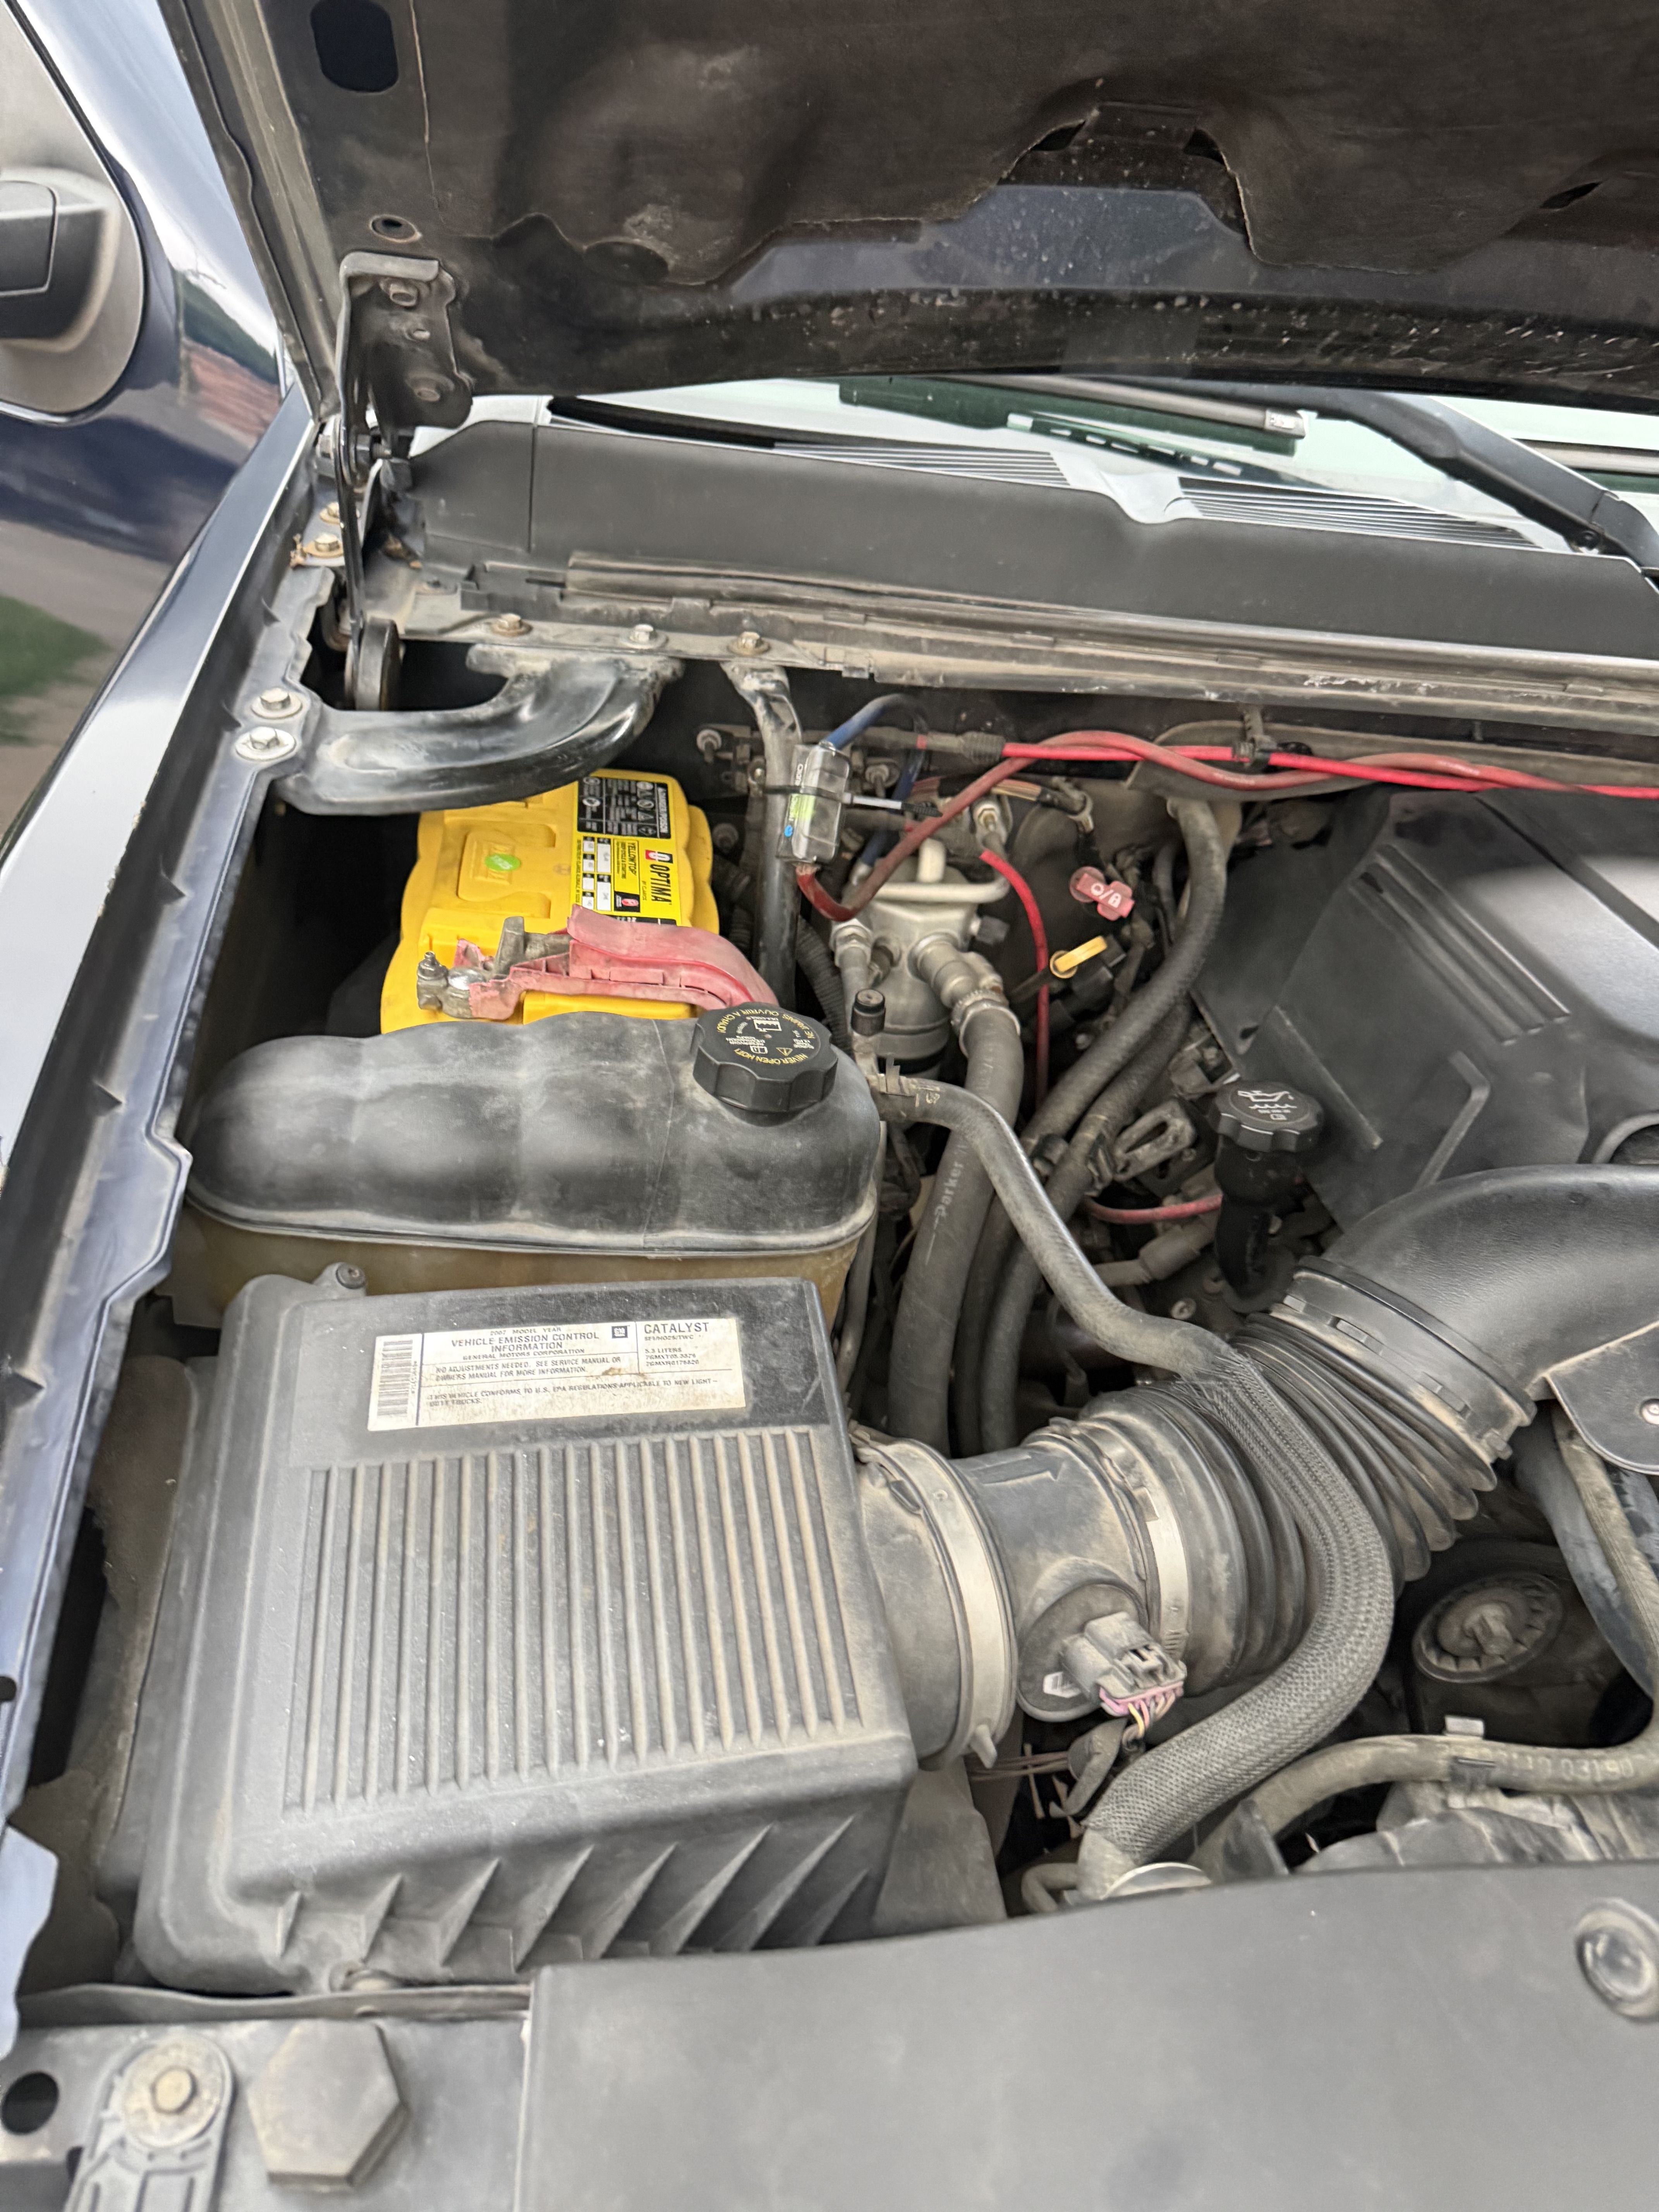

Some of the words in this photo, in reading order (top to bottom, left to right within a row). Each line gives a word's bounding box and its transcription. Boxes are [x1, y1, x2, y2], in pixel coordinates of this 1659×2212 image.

[649, 863, 672, 903] OPTIMA
[756, 1056, 781, 1066] OPEN
[780, 1053, 809, 1064] NEVER
[936, 1162, 965, 1218] Parker
[644, 1322, 709, 1334] CATALYST
[451, 1337, 495, 1347] VEHICLE
[498, 1334, 548, 1344] EMISSION
[552, 1332, 599, 1341] CONTROL
[491, 1341, 563, 1352] INFORMATION
[449, 1363, 499, 1372] ADJUSTMENTS
[468, 1372, 497, 1380] MANUAL
[516, 1368, 536, 1376] MORE
[538, 1366, 588, 1375] INFORMATION.
[480, 1388, 521, 1397] CONFORMS
[568, 1382, 617, 1391] REGULATIONS
[619, 1380, 660, 1388] APPLICABLE
